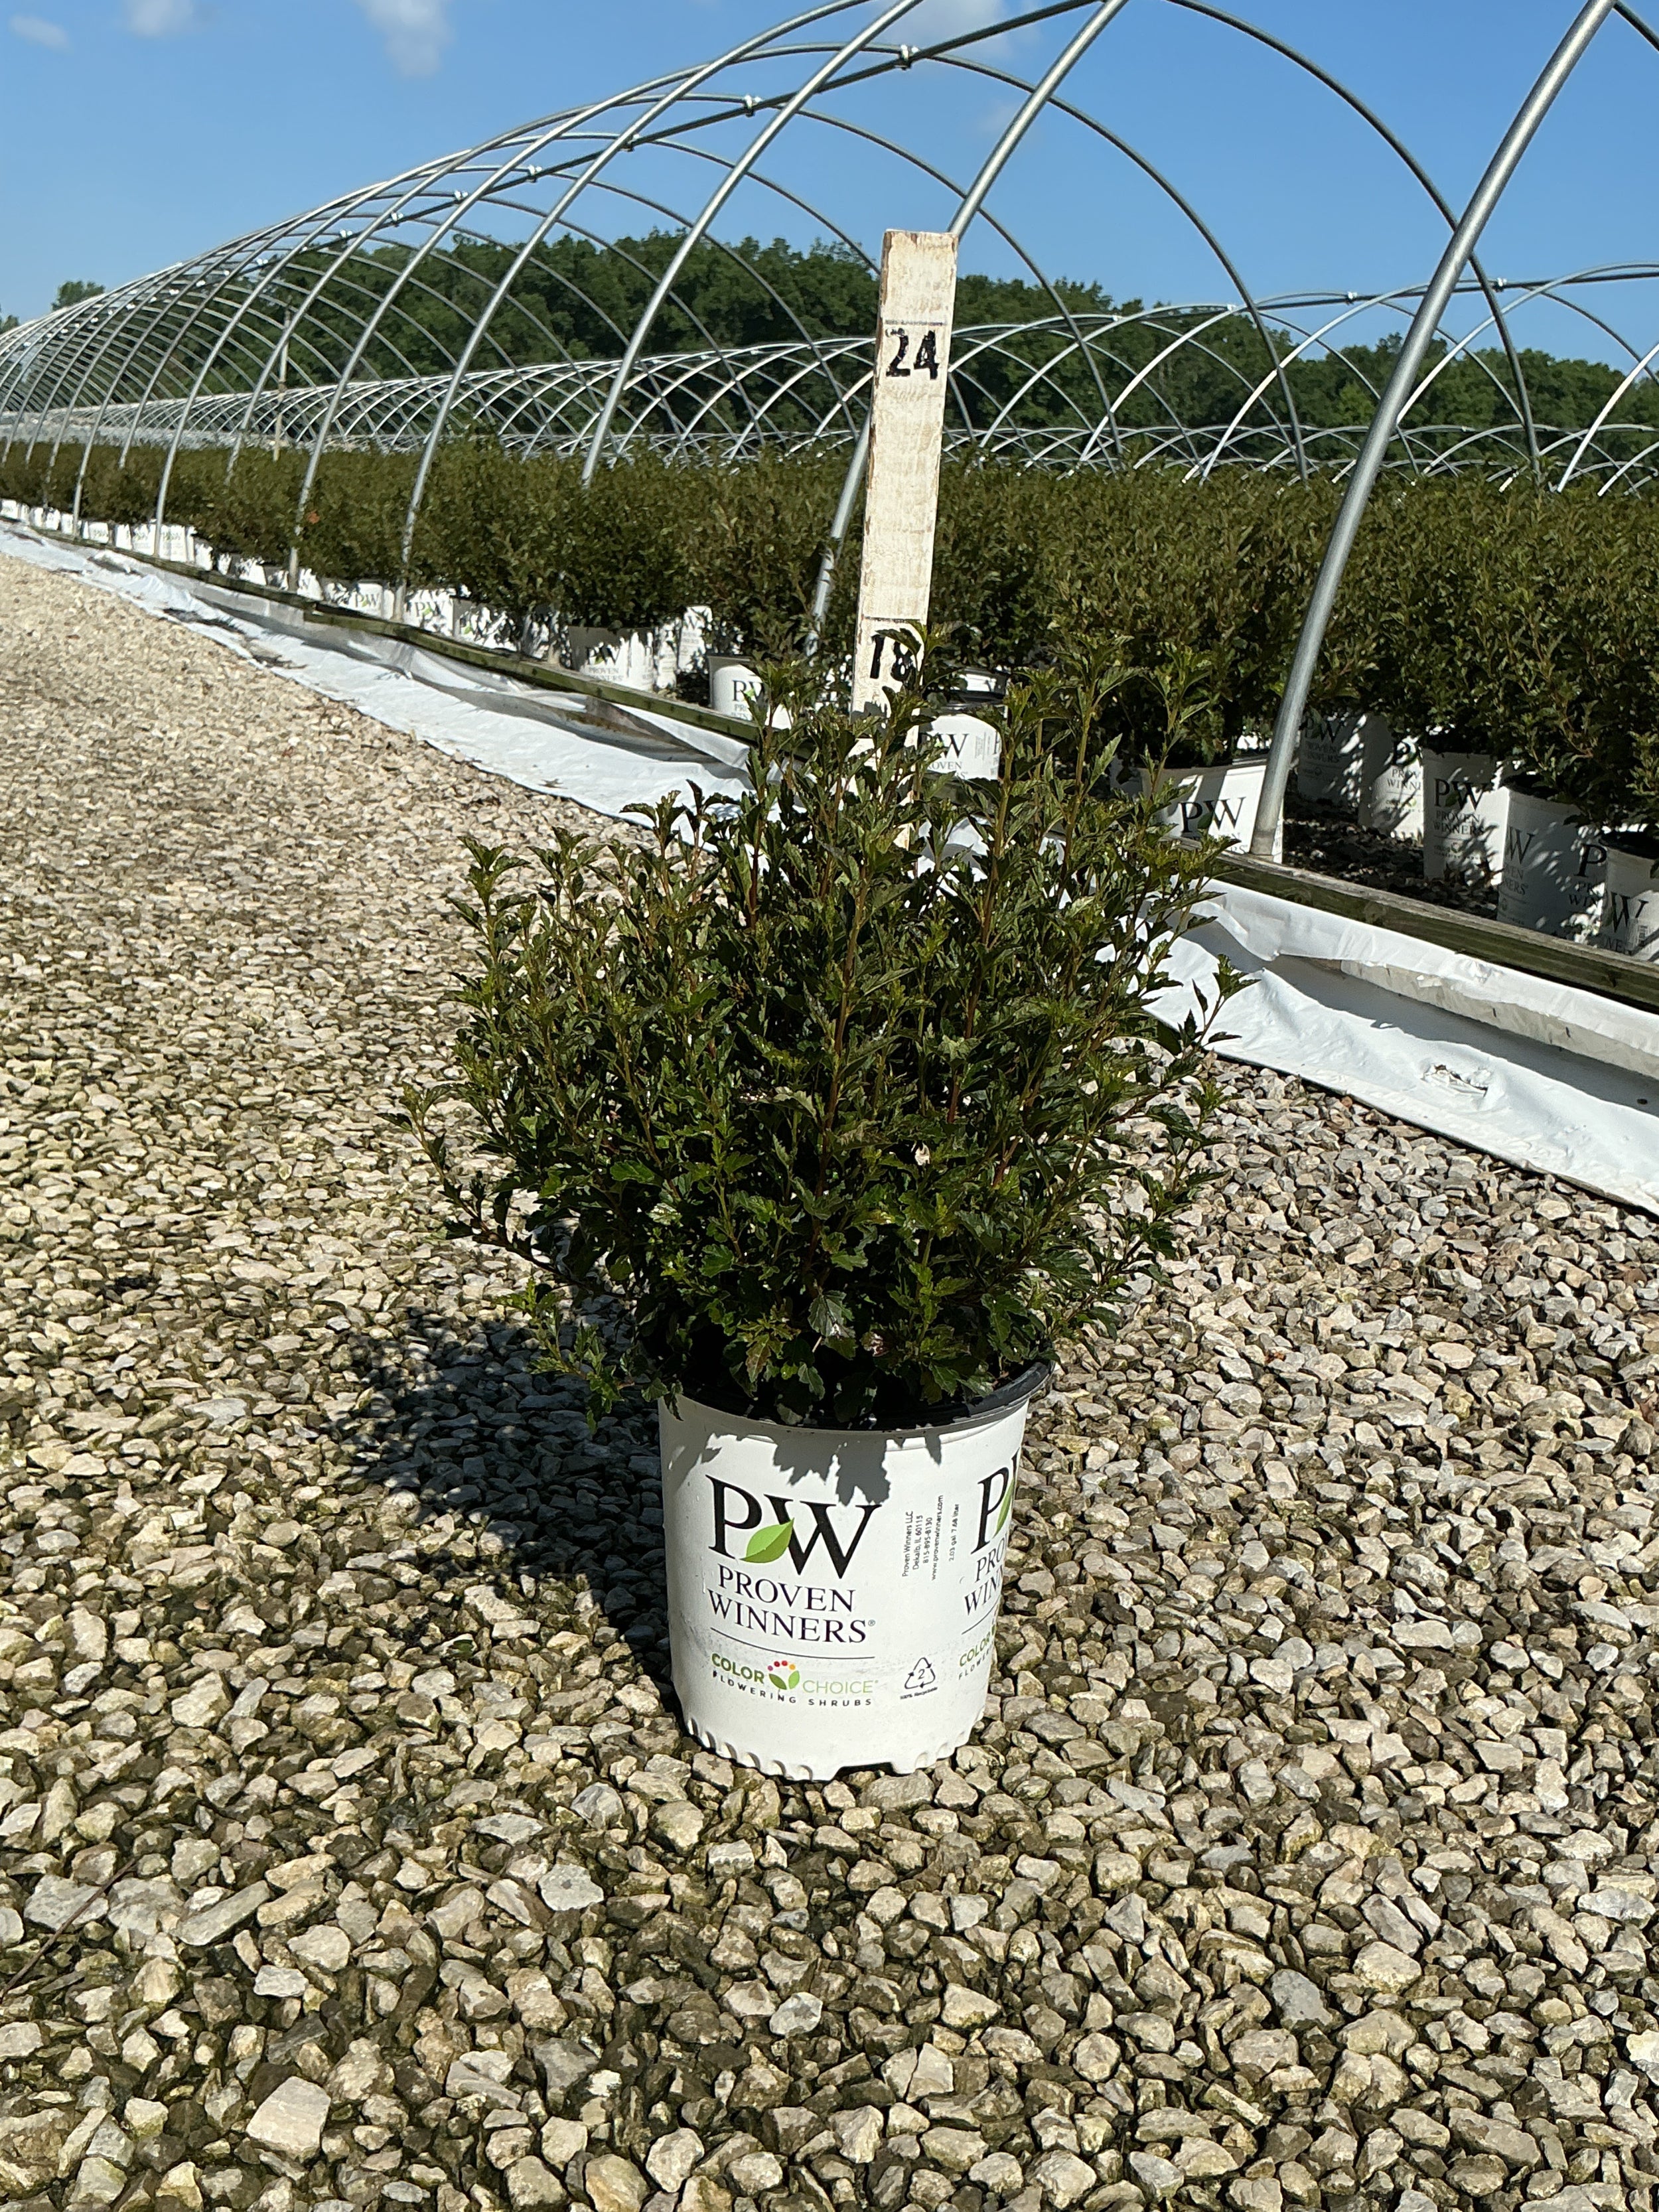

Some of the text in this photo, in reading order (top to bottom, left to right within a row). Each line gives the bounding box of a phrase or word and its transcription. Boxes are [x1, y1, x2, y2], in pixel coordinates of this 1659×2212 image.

[885, 327, 940, 380] 24
[870, 634, 916, 682] 18
[928, 761, 962, 770] OVEN
[1434, 778, 1488, 810] PW
[1177, 796, 1247, 833] PW
[705, 1474, 883, 1580] PW
[903, 1525, 912, 1553] Winners
[922, 1517, 933, 1564] 815-895-8130
[931, 1495, 944, 1581] www.provenwinners.com
[902, 1553, 910, 1578] Proven
[912, 1544, 922, 1570] Dekalb,
[717, 1563, 856, 1613] PROVEN
[711, 1653, 875, 1694] COLOR CHOICE
[712, 1670, 873, 1707] FLOWERING SHRUBS
